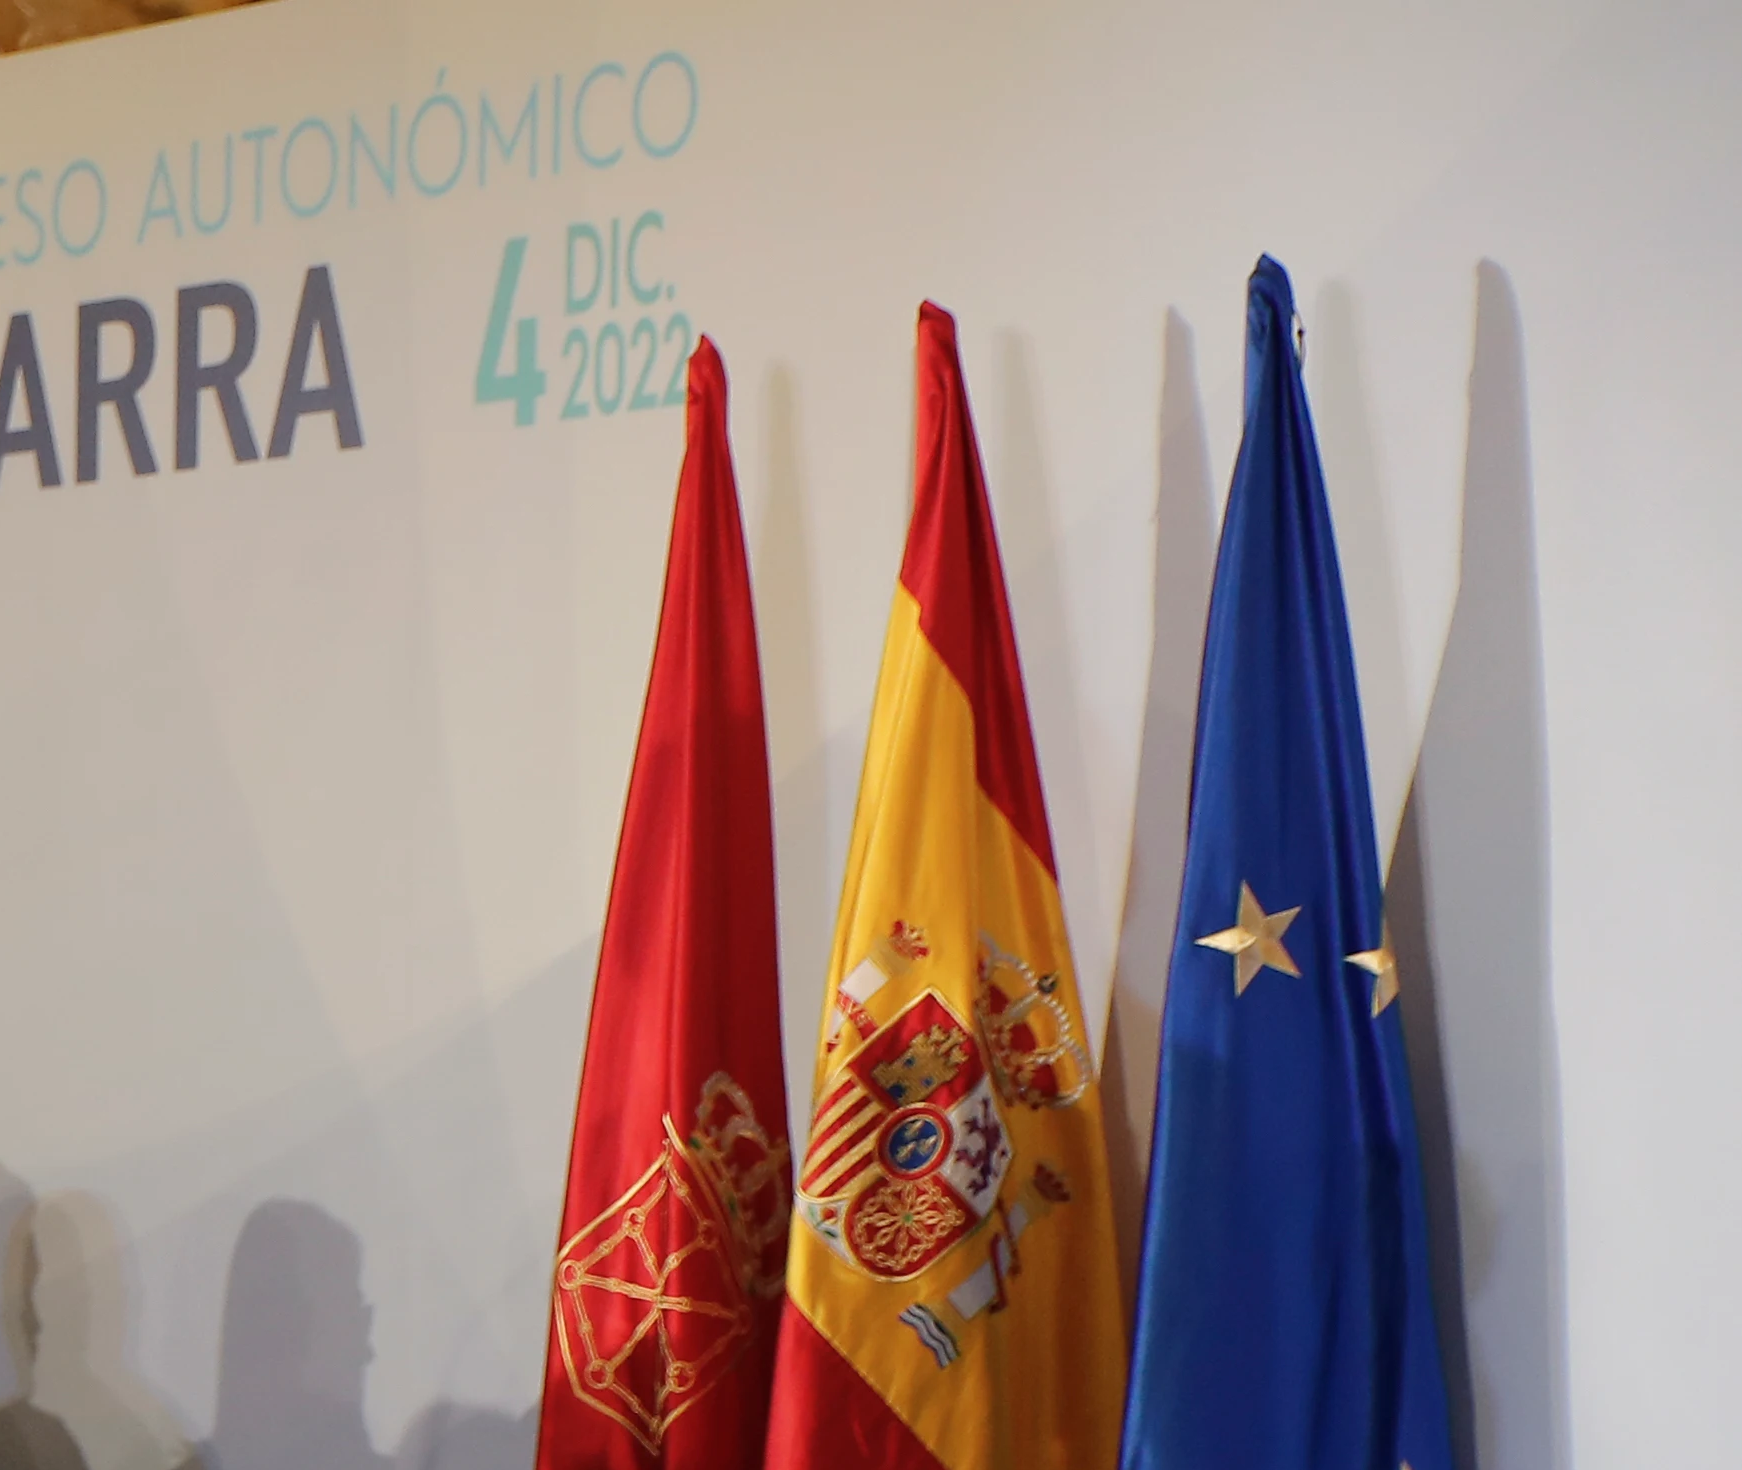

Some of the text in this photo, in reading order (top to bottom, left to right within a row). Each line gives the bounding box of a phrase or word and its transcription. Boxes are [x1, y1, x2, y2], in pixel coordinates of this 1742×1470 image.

[136, 50, 701, 246] AUTONÓMICO
[473, 236, 548, 429] 4
[562, 208, 677, 318] DIC.
[559, 311, 692, 421] 2022
